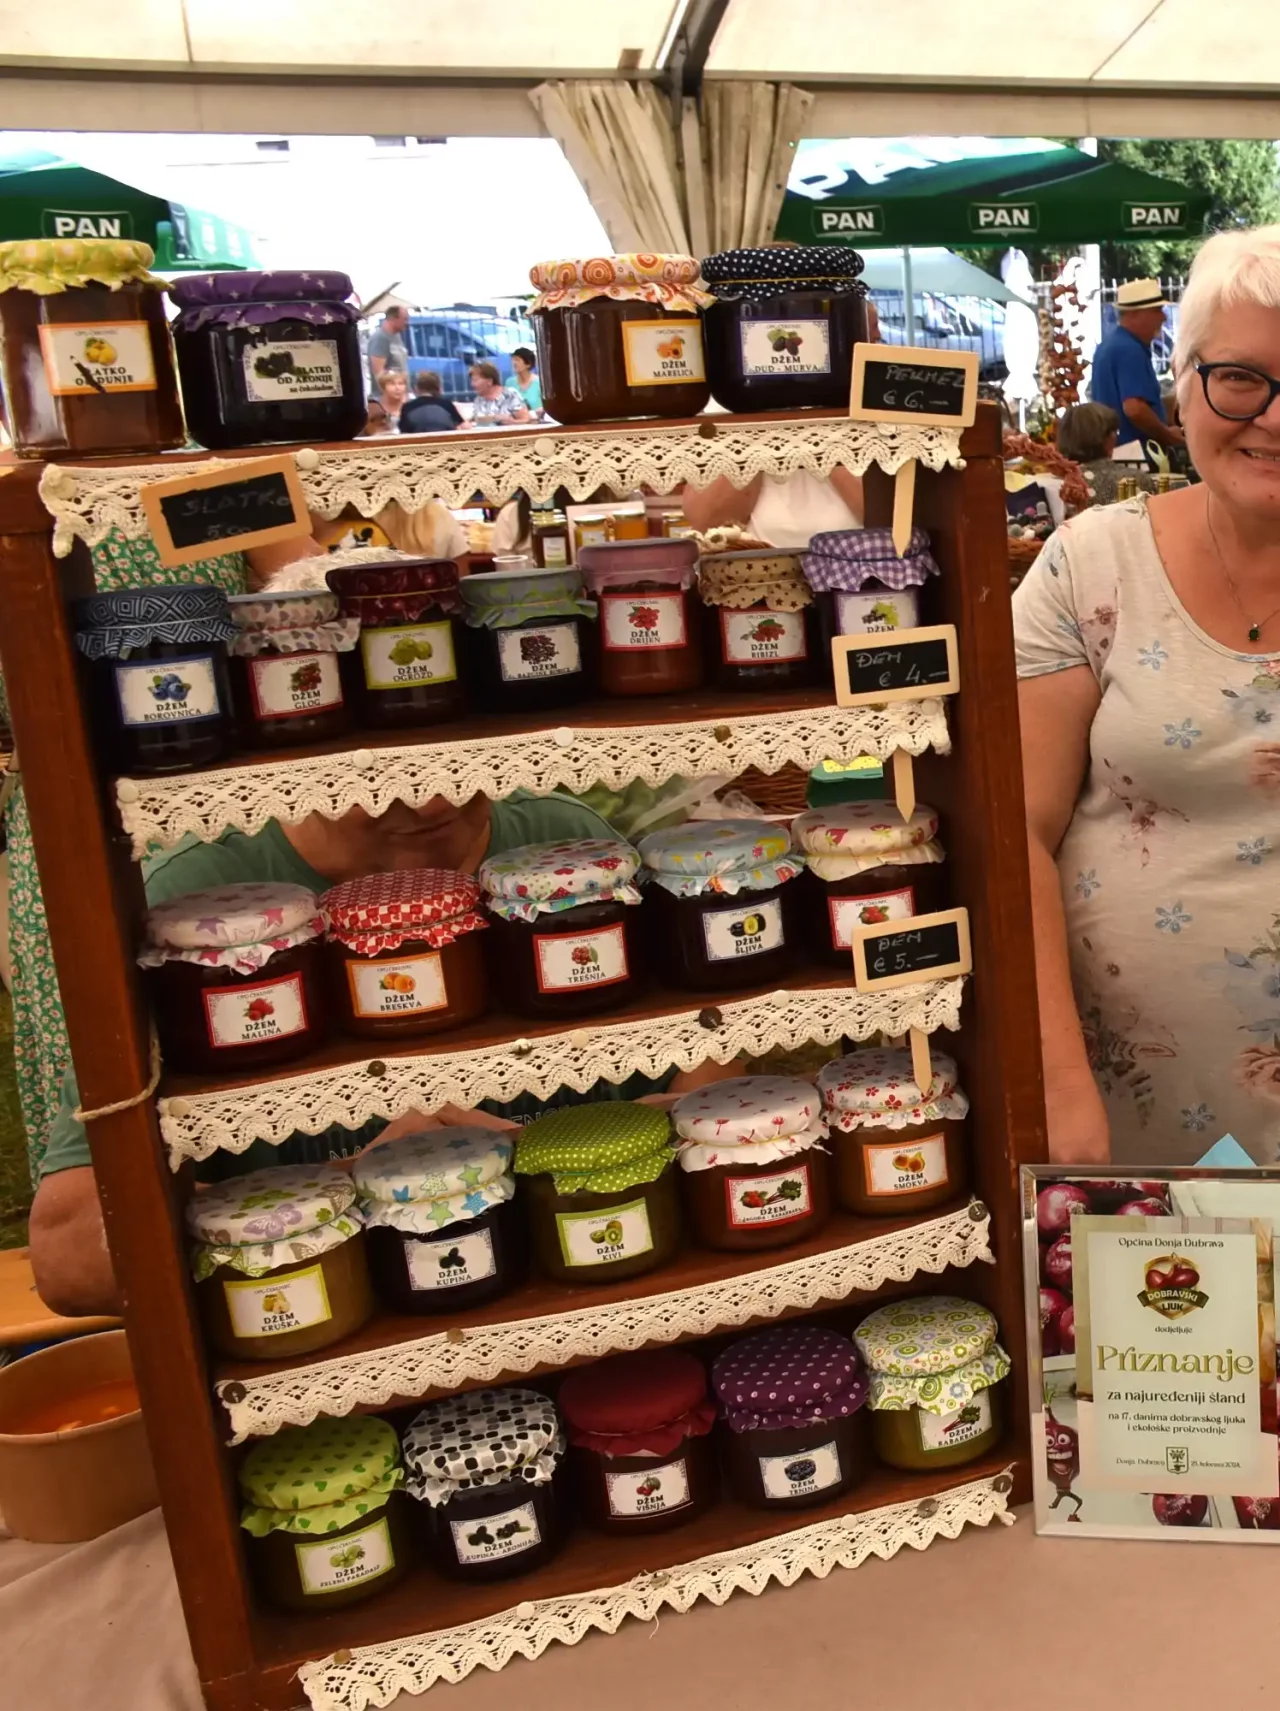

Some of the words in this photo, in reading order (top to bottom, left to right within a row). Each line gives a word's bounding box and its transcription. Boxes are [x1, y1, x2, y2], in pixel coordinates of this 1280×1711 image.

[821, 211, 875, 230] PAN
[978, 208, 1030, 227] PAN
[1131, 207, 1180, 225] PAN
[54, 216, 121, 238] PAN
[662, 360, 687, 369] DŽEM
[771, 355, 801, 364] DŽEM
[653, 368, 694, 378] MARELICA
[755, 365, 775, 373] DUD
[785, 364, 818, 372] MURVA
[277, 377, 293, 385] OD
[296, 375, 333, 384] ARONIJE
[631, 629, 658, 638] DŽEM
[867, 625, 894, 633] DŽEM
[751, 642, 779, 651] DŽEM
[397, 665, 427, 675] DŽEM
[531, 663, 558, 672] DŽEM
[393, 671, 433, 682] OGROZD
[879, 671, 892, 688] €
[291, 690, 321, 701] DŽEM
[156, 700, 187, 712] DŽEM
[295, 698, 321, 709] GLOG
[144, 708, 202, 721] BOROVNICA
[735, 935, 762, 947] DŽEM
[735, 943, 763, 955] ŠLJIVA
[572, 965, 601, 975] DŽEM
[874, 957, 887, 972] €
[567, 971, 606, 984] TREŠNJA
[385, 993, 415, 1003] DŽEM
[380, 1000, 422, 1011] BRESKVA
[245, 1020, 277, 1031] DŽEM
[241, 1027, 282, 1040] MALINA
[898, 1173, 924, 1182] DŽEM
[894, 1178, 929, 1190] SMOKVA
[760, 1205, 787, 1215] DŽEM
[1118, 1237, 1153, 1248] Općina
[1154, 1237, 1182, 1248] Donja
[1184, 1238, 1224, 1248] Dubrava
[597, 1243, 625, 1254] DŽEM
[602, 1252, 623, 1261] KIVI
[438, 1267, 467, 1278] DŽEM
[436, 1274, 472, 1286] KUPINA
[1147, 1290, 1198, 1302] DOBRAVSKI
[1161, 1302, 1184, 1311] LJUK
[263, 1312, 295, 1324] DŽEM
[261, 1319, 300, 1332] KRUŠKA
[1154, 1325, 1193, 1335] dodjeljuje
[1096, 1345, 1254, 1382] Priznanje
[1107, 1390, 1121, 1401] za
[1108, 1412, 1119, 1420] na
[1133, 1412, 1168, 1421] danima
[1169, 1413, 1222, 1425] dobravskog
[1223, 1414, 1246, 1425] ljuka
[949, 1426, 973, 1438] DŽEM
[1132, 1424, 1171, 1433] ekološke
[1173, 1424, 1227, 1435] proizvodnje
[938, 1428, 983, 1447] RABARBARA
[791, 1479, 815, 1489] DŽEM
[789, 1485, 819, 1495] TRNINA
[637, 1495, 664, 1505] DŽEM
[636, 1501, 666, 1512] VIŠNJA
[466, 1551, 492, 1560] KUPINA
[501, 1540, 532, 1554] ARONIJA
[484, 1540, 512, 1552] DŽEM
[335, 1564, 365, 1579] DŽEM
[320, 1576, 345, 1587] ZELENI
